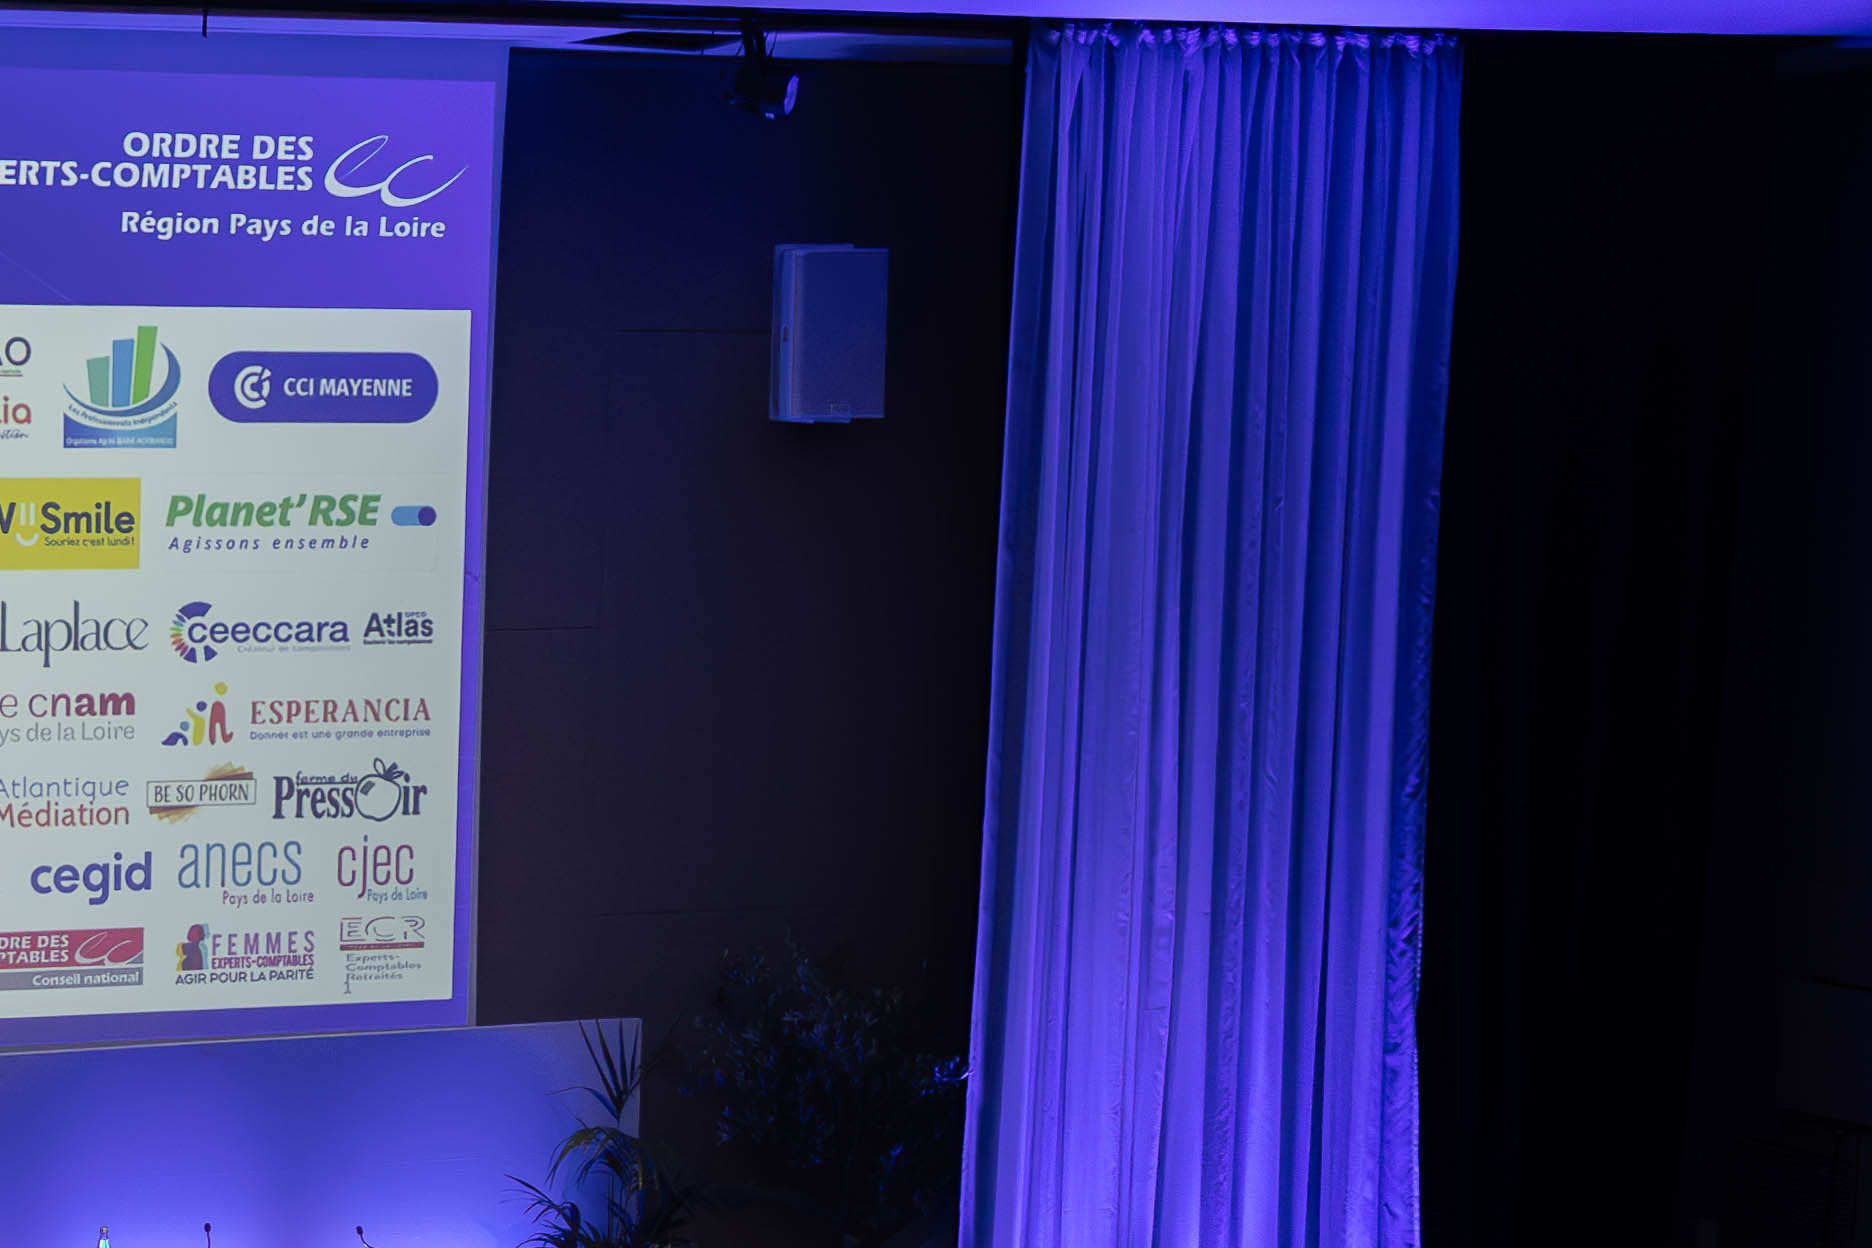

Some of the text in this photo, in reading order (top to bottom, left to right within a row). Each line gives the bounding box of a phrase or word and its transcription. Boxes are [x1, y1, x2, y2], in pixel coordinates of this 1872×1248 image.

[123, 131, 313, 160] ORDRE DES
[121, 212, 446, 242] Région Pays de la Loire
[283, 377, 413, 397] CCI MAYENNE
[44, 536, 81, 547] Souriez
[82, 536, 105, 547] c'est
[168, 535, 370, 553] Agissons ensemble
[0, 600, 149, 668] Laplace
[187, 621, 350, 644] ceeccara
[363, 612, 434, 638] Atlas
[28, 692, 136, 718] cnam
[250, 698, 431, 725] ESPERANCIA
[26, 722, 52, 742] de
[57, 721, 76, 741] la
[81, 719, 135, 741] Loire
[250, 727, 431, 741] Donner est une grande entreprise
[154, 782, 249, 803] BE SO PHORN
[178, 841, 302, 888] anecs
[337, 835, 414, 898] cjec
[31, 851, 153, 905] cegid
[222, 889, 314, 908] Pays de la Loire
[340, 916, 425, 942] ECR
[37, 934, 69, 949] DES
[211, 931, 315, 956] FEMMES
[211, 954, 315, 969] EXPERTS-COMPTABLES
[32, 970, 139, 986] Conseil national
[175, 967, 314, 985] AGIR POUR LA PARITÉ
